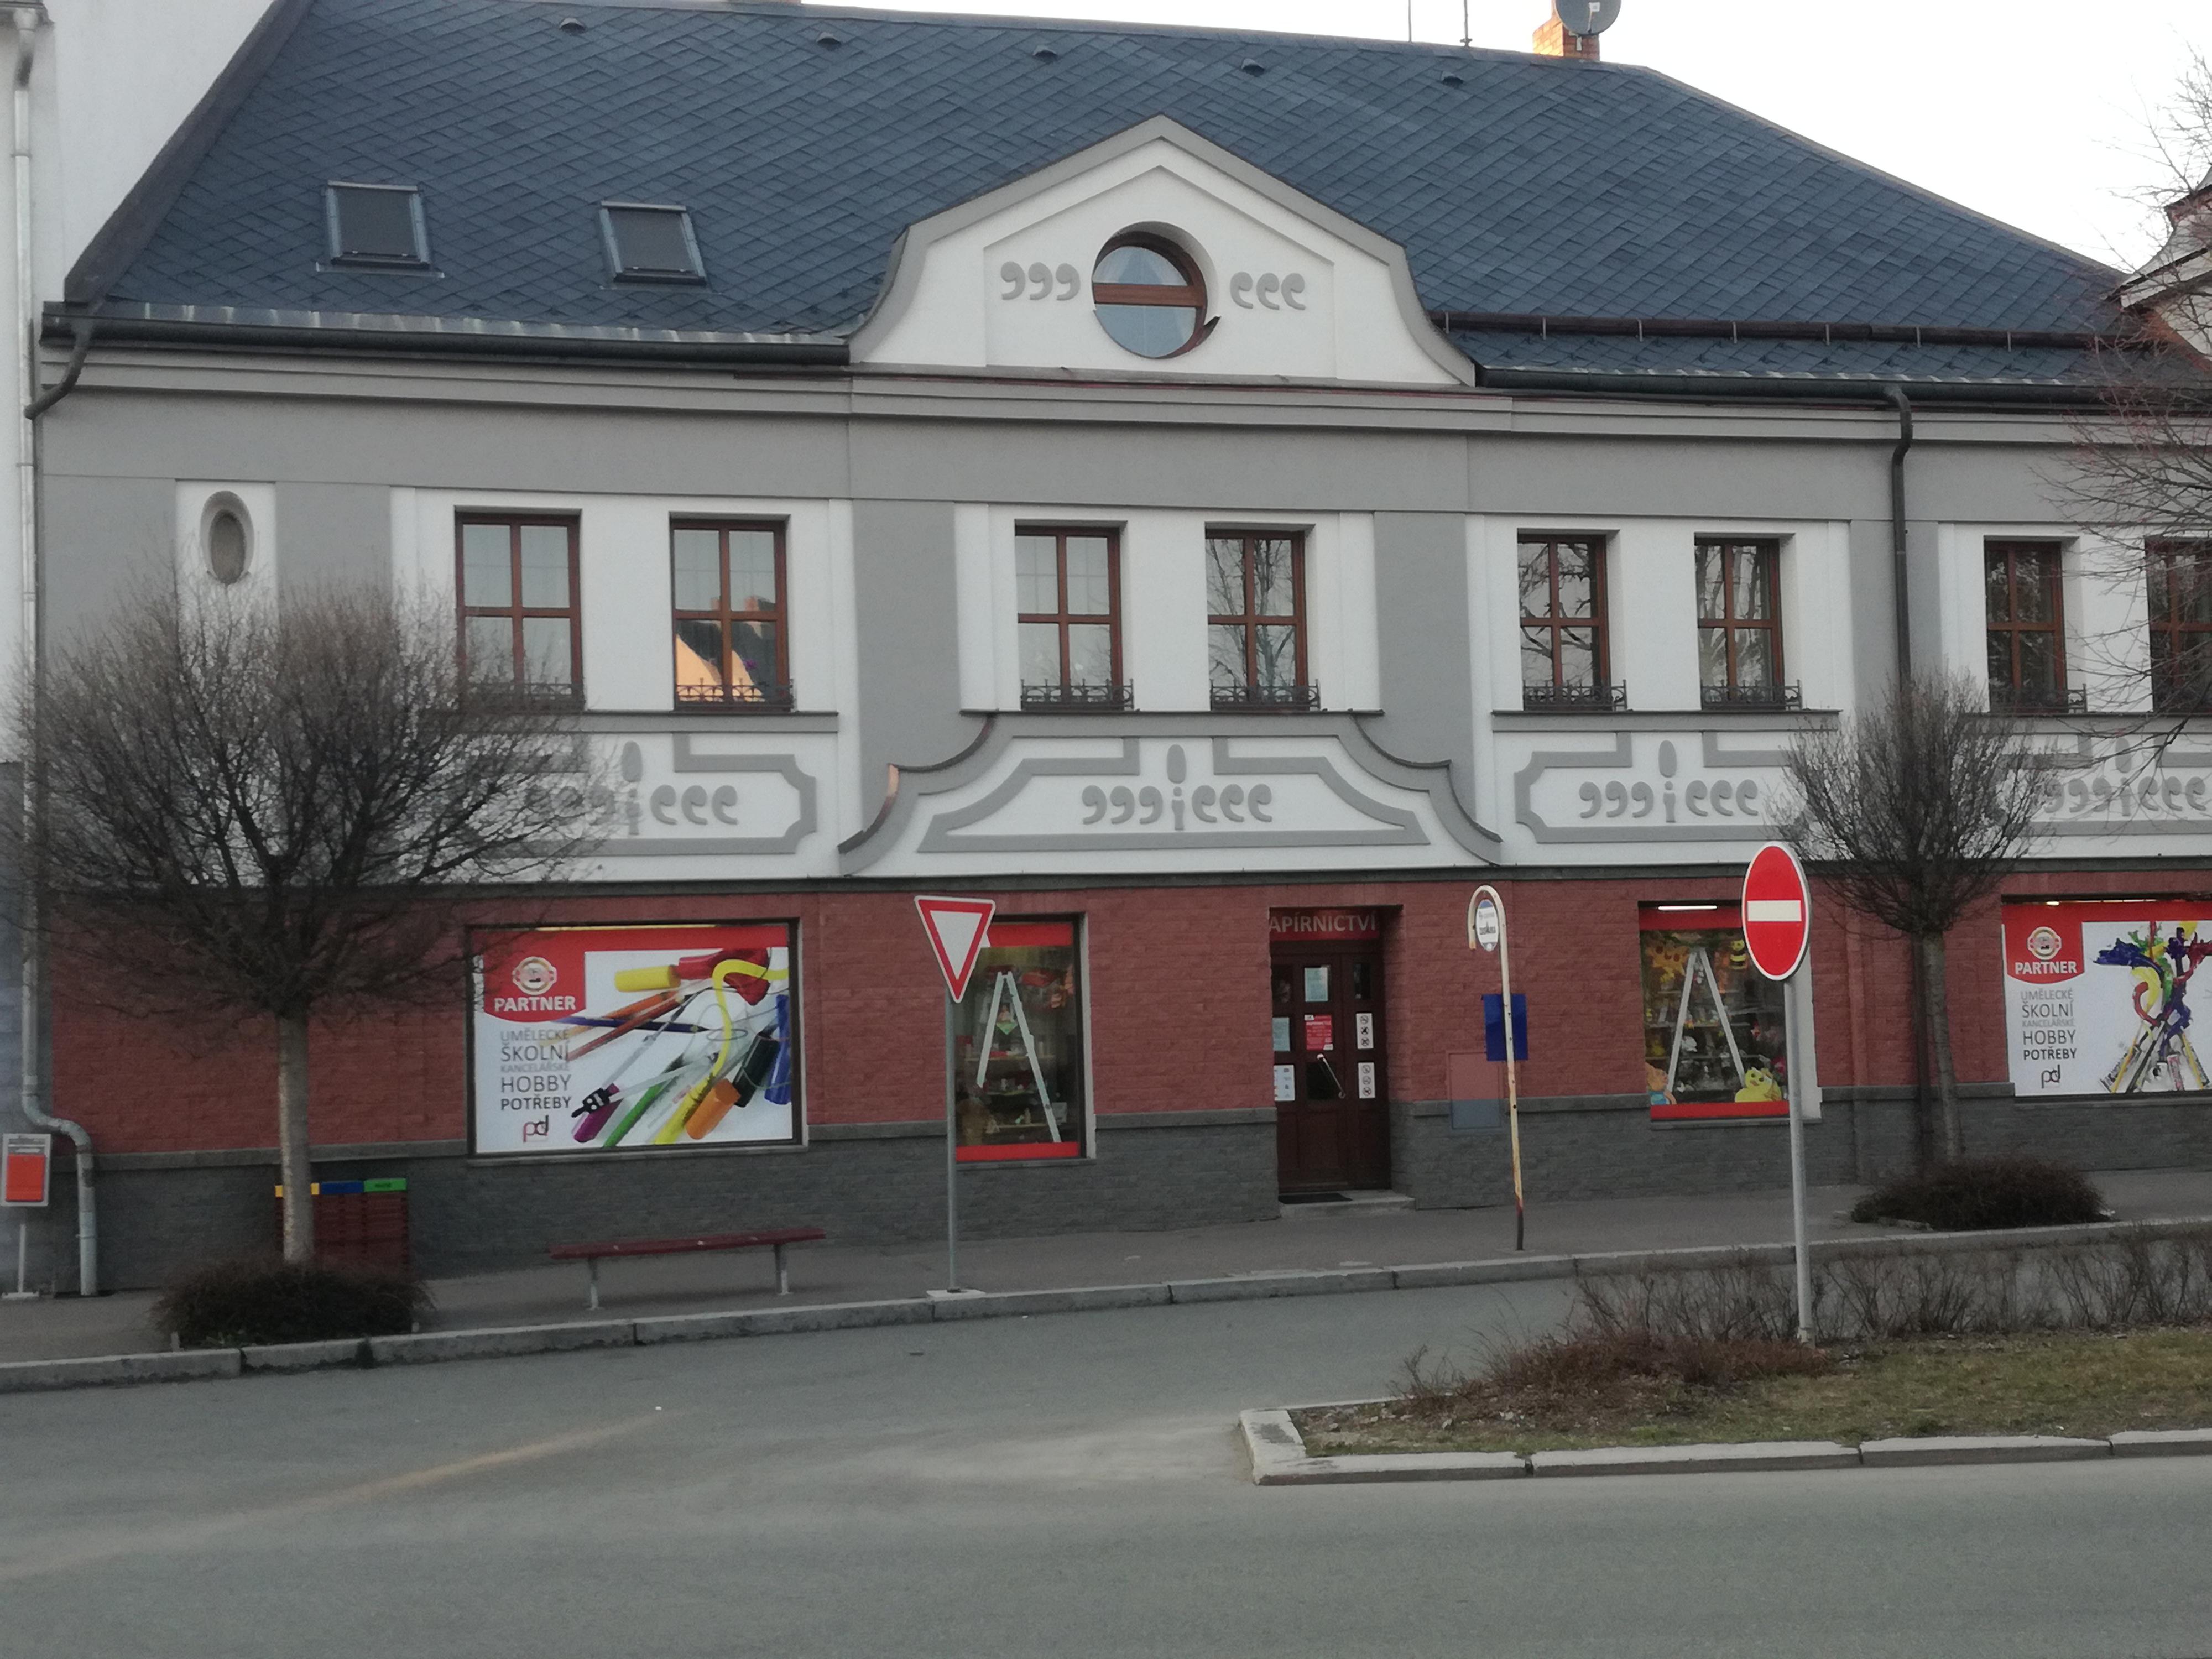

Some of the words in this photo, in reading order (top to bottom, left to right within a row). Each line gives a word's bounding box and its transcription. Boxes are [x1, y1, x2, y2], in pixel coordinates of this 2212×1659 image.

[2015, 961, 2077, 974] PARTNER
[2020, 987, 2074, 1000] UMĚLECKÉ
[494, 995, 577, 1012] PARTNER
[2021, 999, 2074, 1018] ŠKOLNÍ
[2022, 1029, 2076, 1045] HOBBY
[500, 1041, 570, 1062] ŠKOLNÍ
[2023, 1046, 2077, 1061] POTŘEBY
[500, 1074, 572, 1093] HOBBY
[500, 1093, 572, 1110] POTŘEBY
